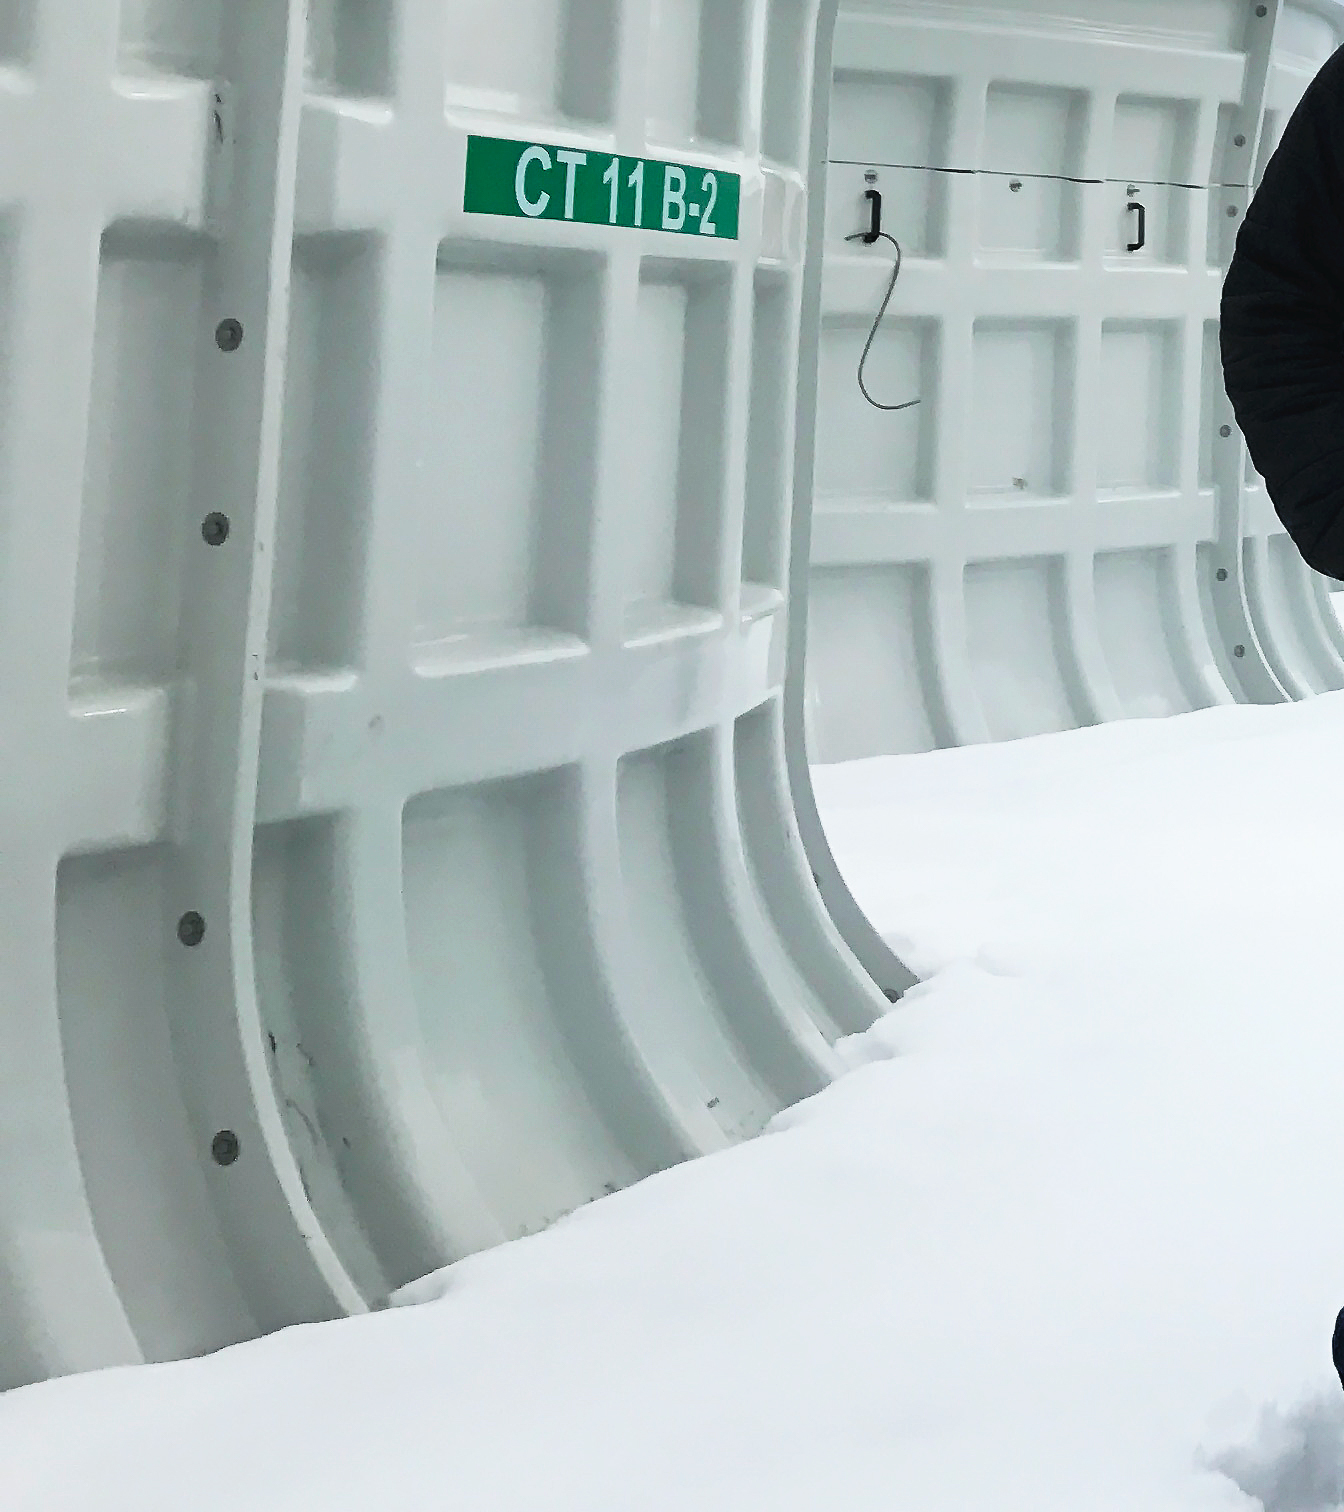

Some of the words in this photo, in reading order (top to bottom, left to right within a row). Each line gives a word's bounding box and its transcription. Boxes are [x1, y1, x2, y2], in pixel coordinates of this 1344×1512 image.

[515, 146, 587, 219] CT
[603, 157, 644, 227] 11
[662, 165, 718, 235] B-2
